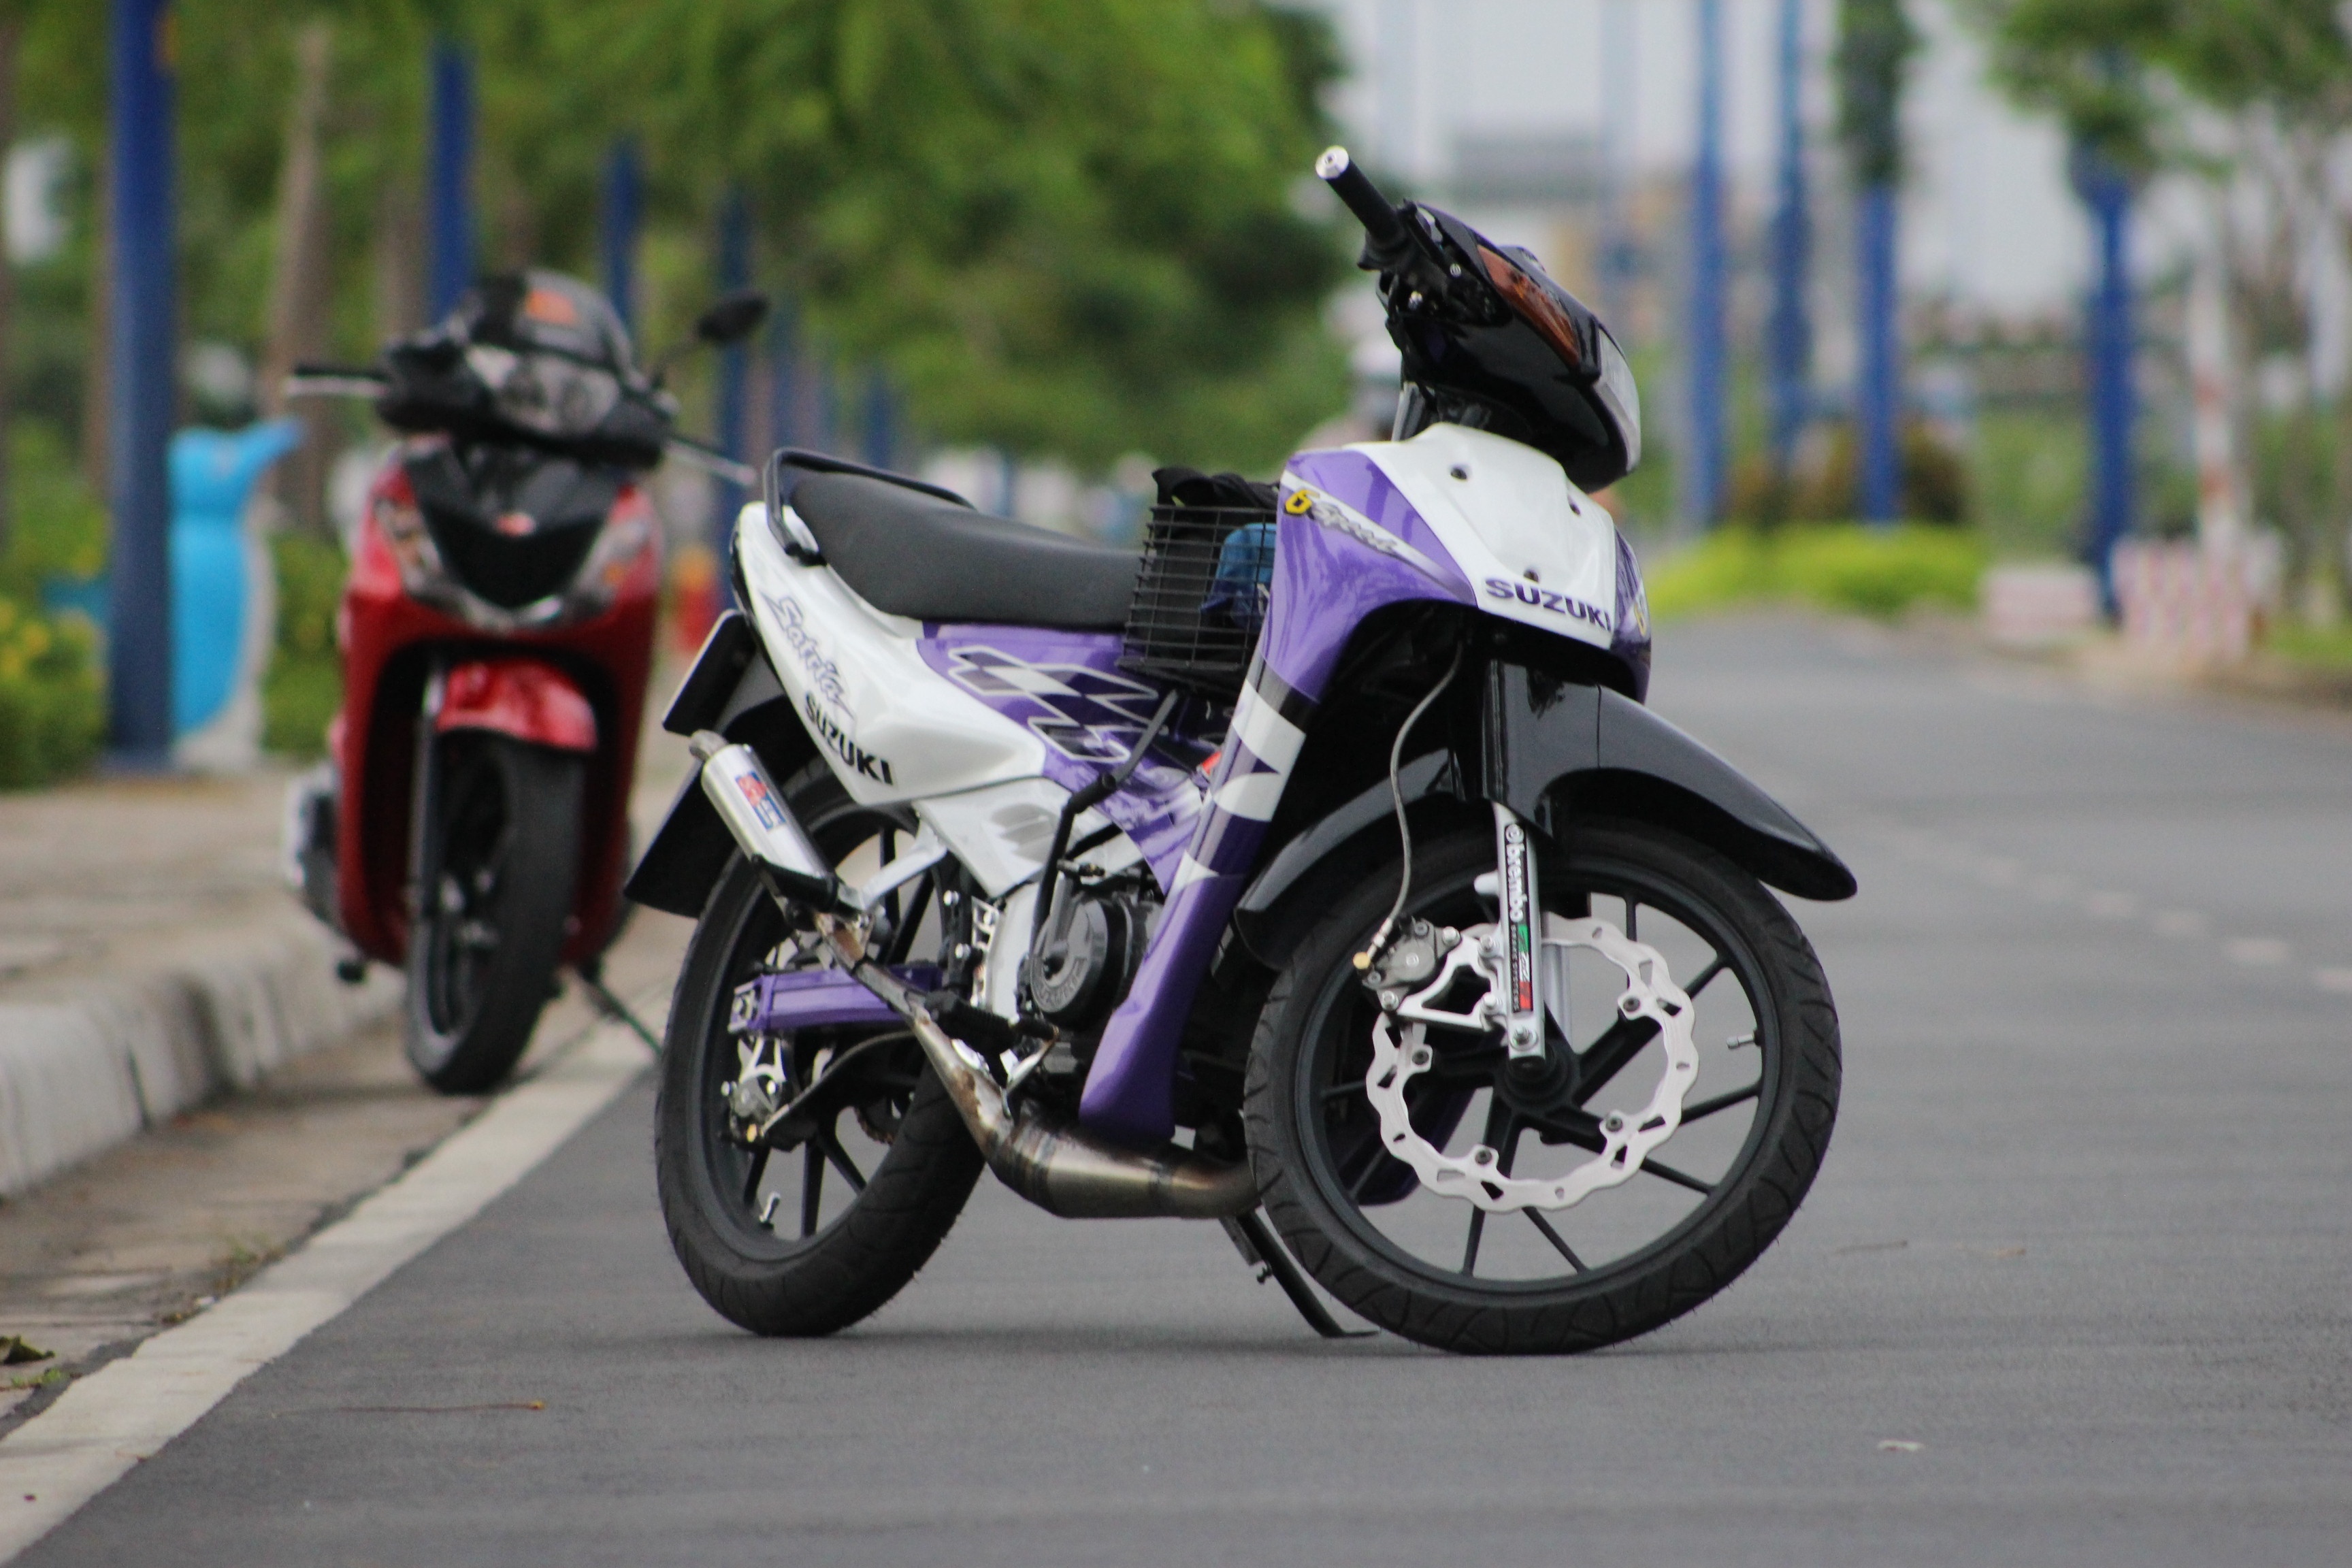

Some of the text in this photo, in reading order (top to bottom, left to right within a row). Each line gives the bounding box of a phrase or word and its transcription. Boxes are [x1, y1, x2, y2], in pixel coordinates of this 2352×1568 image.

[1286, 489, 1320, 515] 6
[1485, 578, 1612, 632] SUZUKI
[758, 590, 855, 720] Satria
[805, 691, 892, 785] SUZUKI
[1506, 844, 1529, 923] brembo
